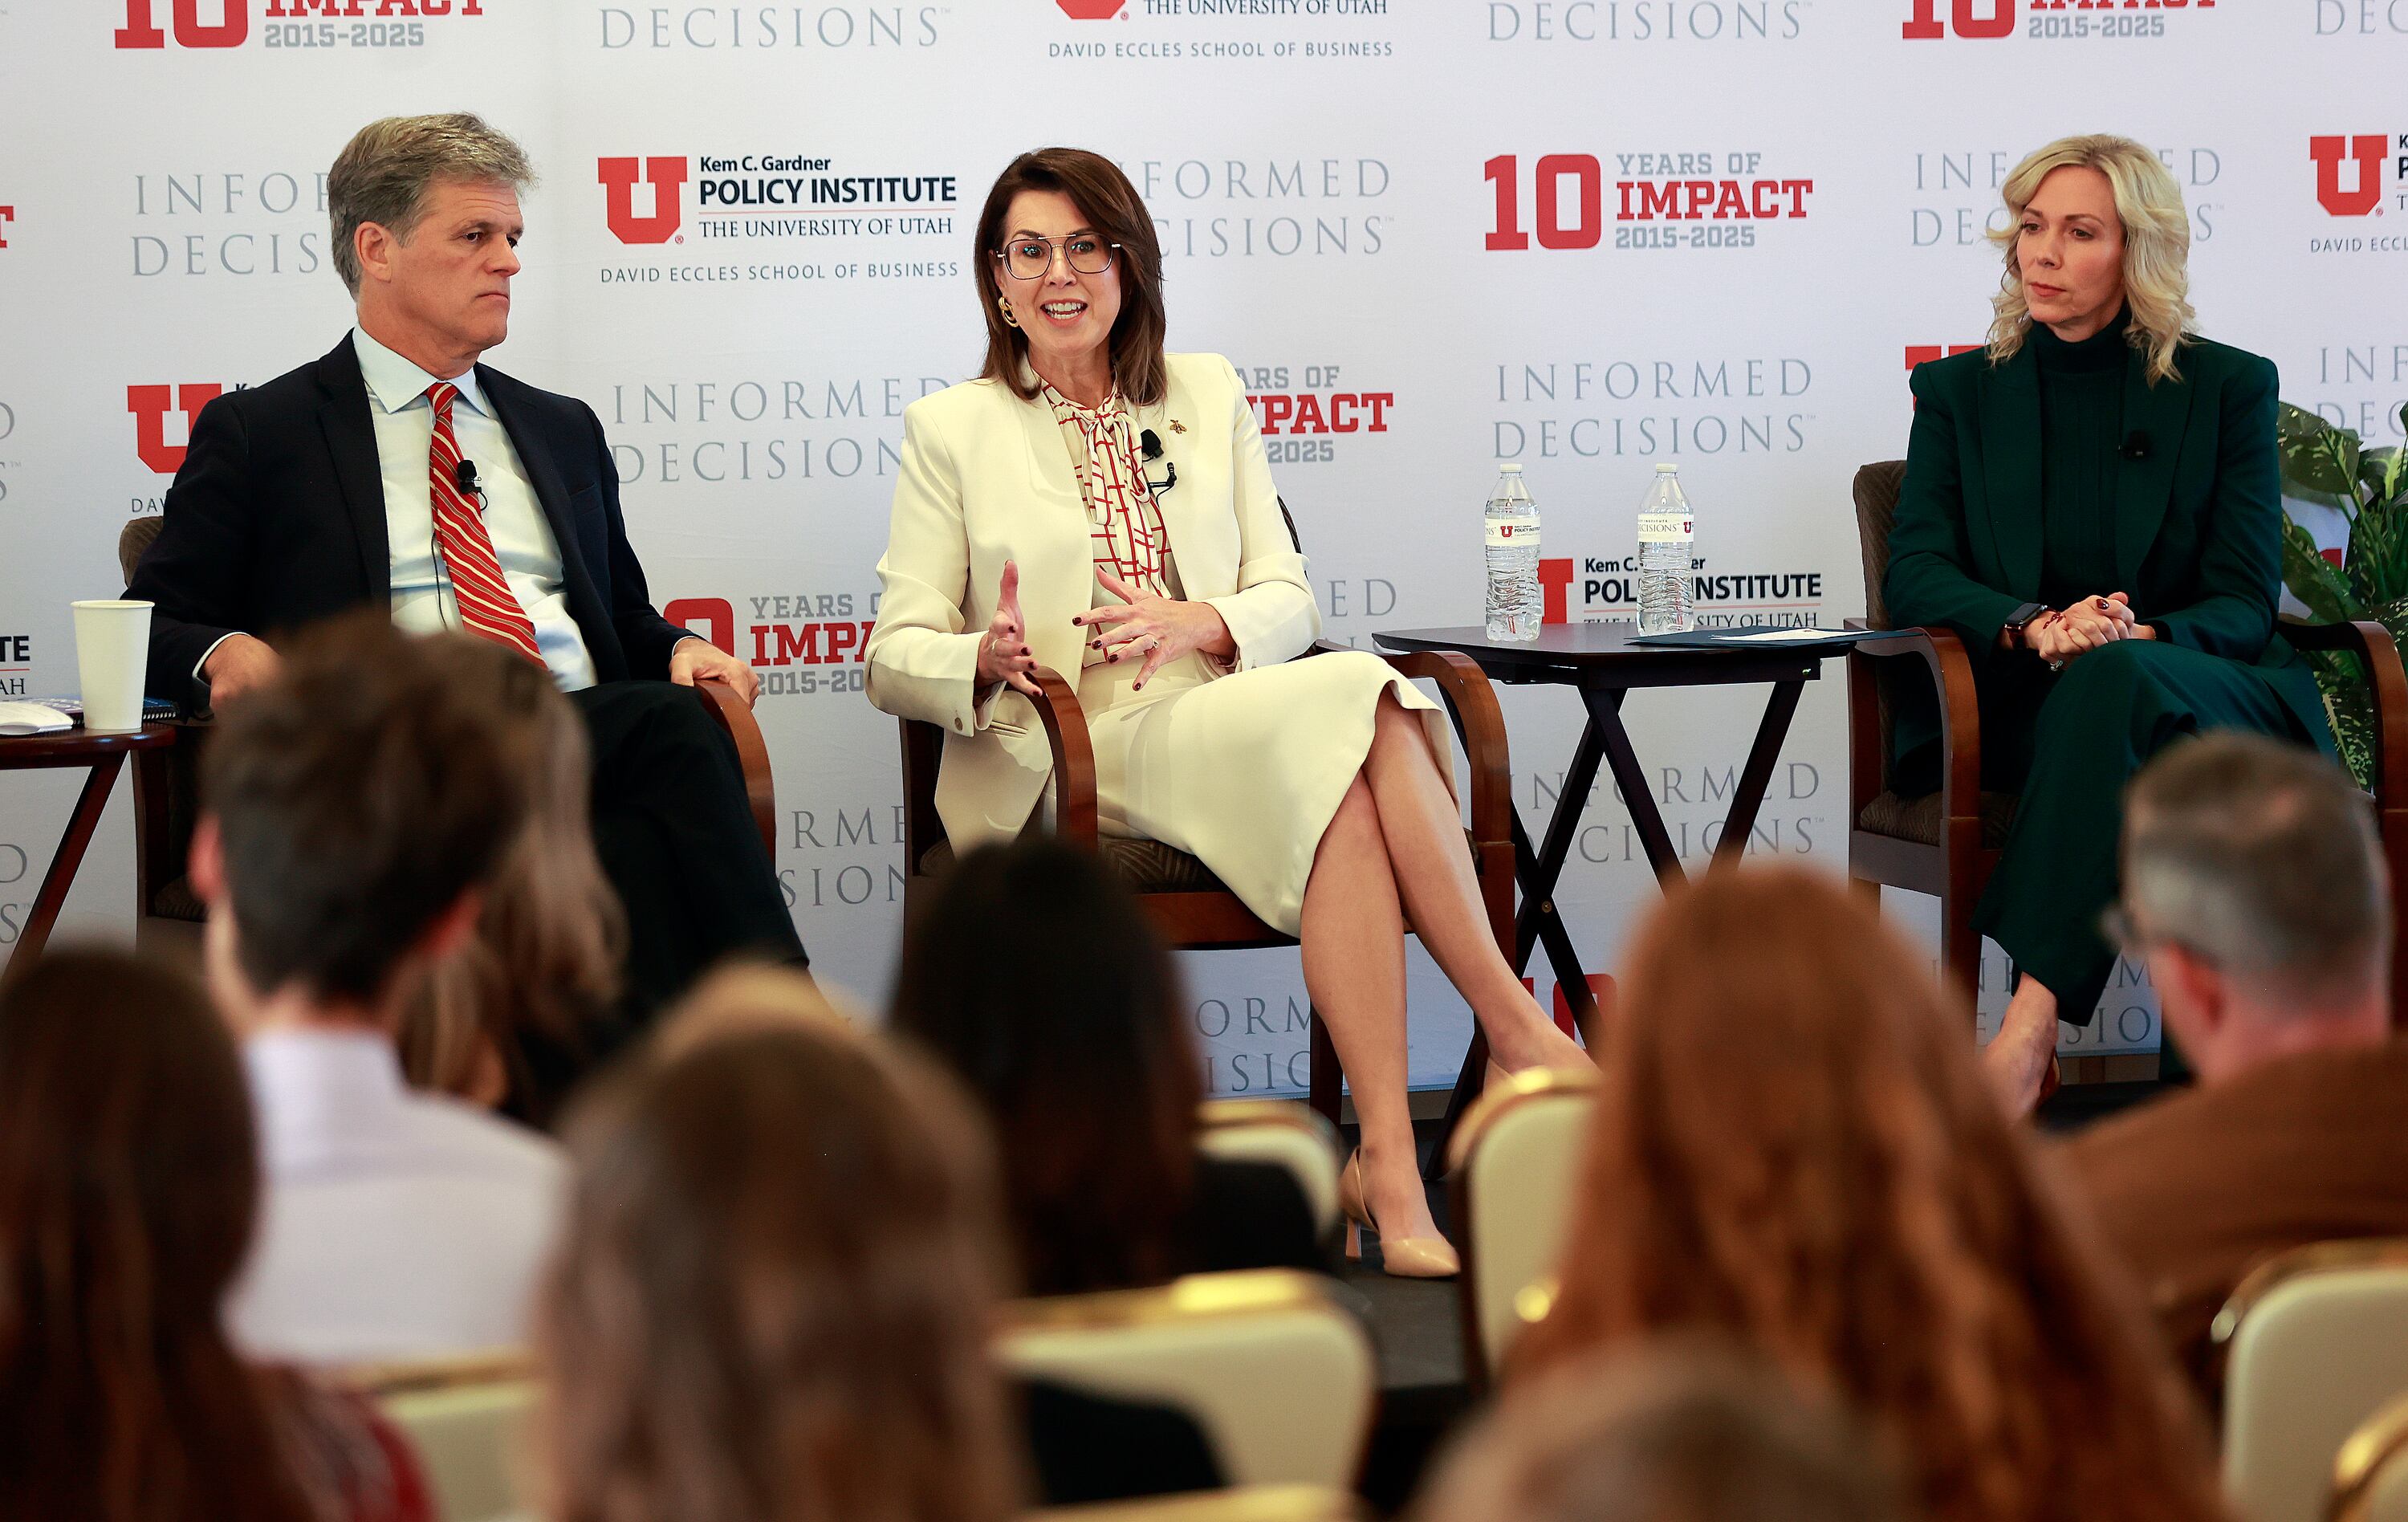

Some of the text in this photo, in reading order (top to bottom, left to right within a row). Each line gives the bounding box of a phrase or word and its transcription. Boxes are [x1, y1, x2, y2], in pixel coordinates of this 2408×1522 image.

[1145, 0, 1388, 14] THE UNIVERSITY OF UTAH
[265, 22, 424, 48] 2015-2025
[2029, 14, 2164, 39] 2015-2025
[1049, 42, 1392, 57] DAVID ECCLES SCHOOL OF BUSINESS
[700, 155, 831, 173] Kem C. Gardner
[700, 177, 956, 206] POLICY INSTITUTE
[1143, 159, 1389, 200] FORMED
[1484, 153, 1761, 250] 10 YEARS OF
[1617, 179, 1813, 221] IMPACT
[698, 218, 952, 238] THE UNIVERSITY OF UTAH
[1616, 225, 1755, 249] 2015-2025
[132, 232, 318, 276] DECIS
[2311, 238, 2362, 253] DAVID
[601, 262, 958, 283] DAVID ECCLES SCHOOL OF BUSINESS
[1305, 365, 1340, 389] OF
[1498, 359, 1811, 402] INFORMED
[1245, 392, 1394, 434] PACT
[611, 437, 905, 483] DECISION
[1584, 557, 1638, 573] Kem C.
[1691, 572, 1822, 600] NSTITUTE
[750, 594, 853, 620] YEARS
